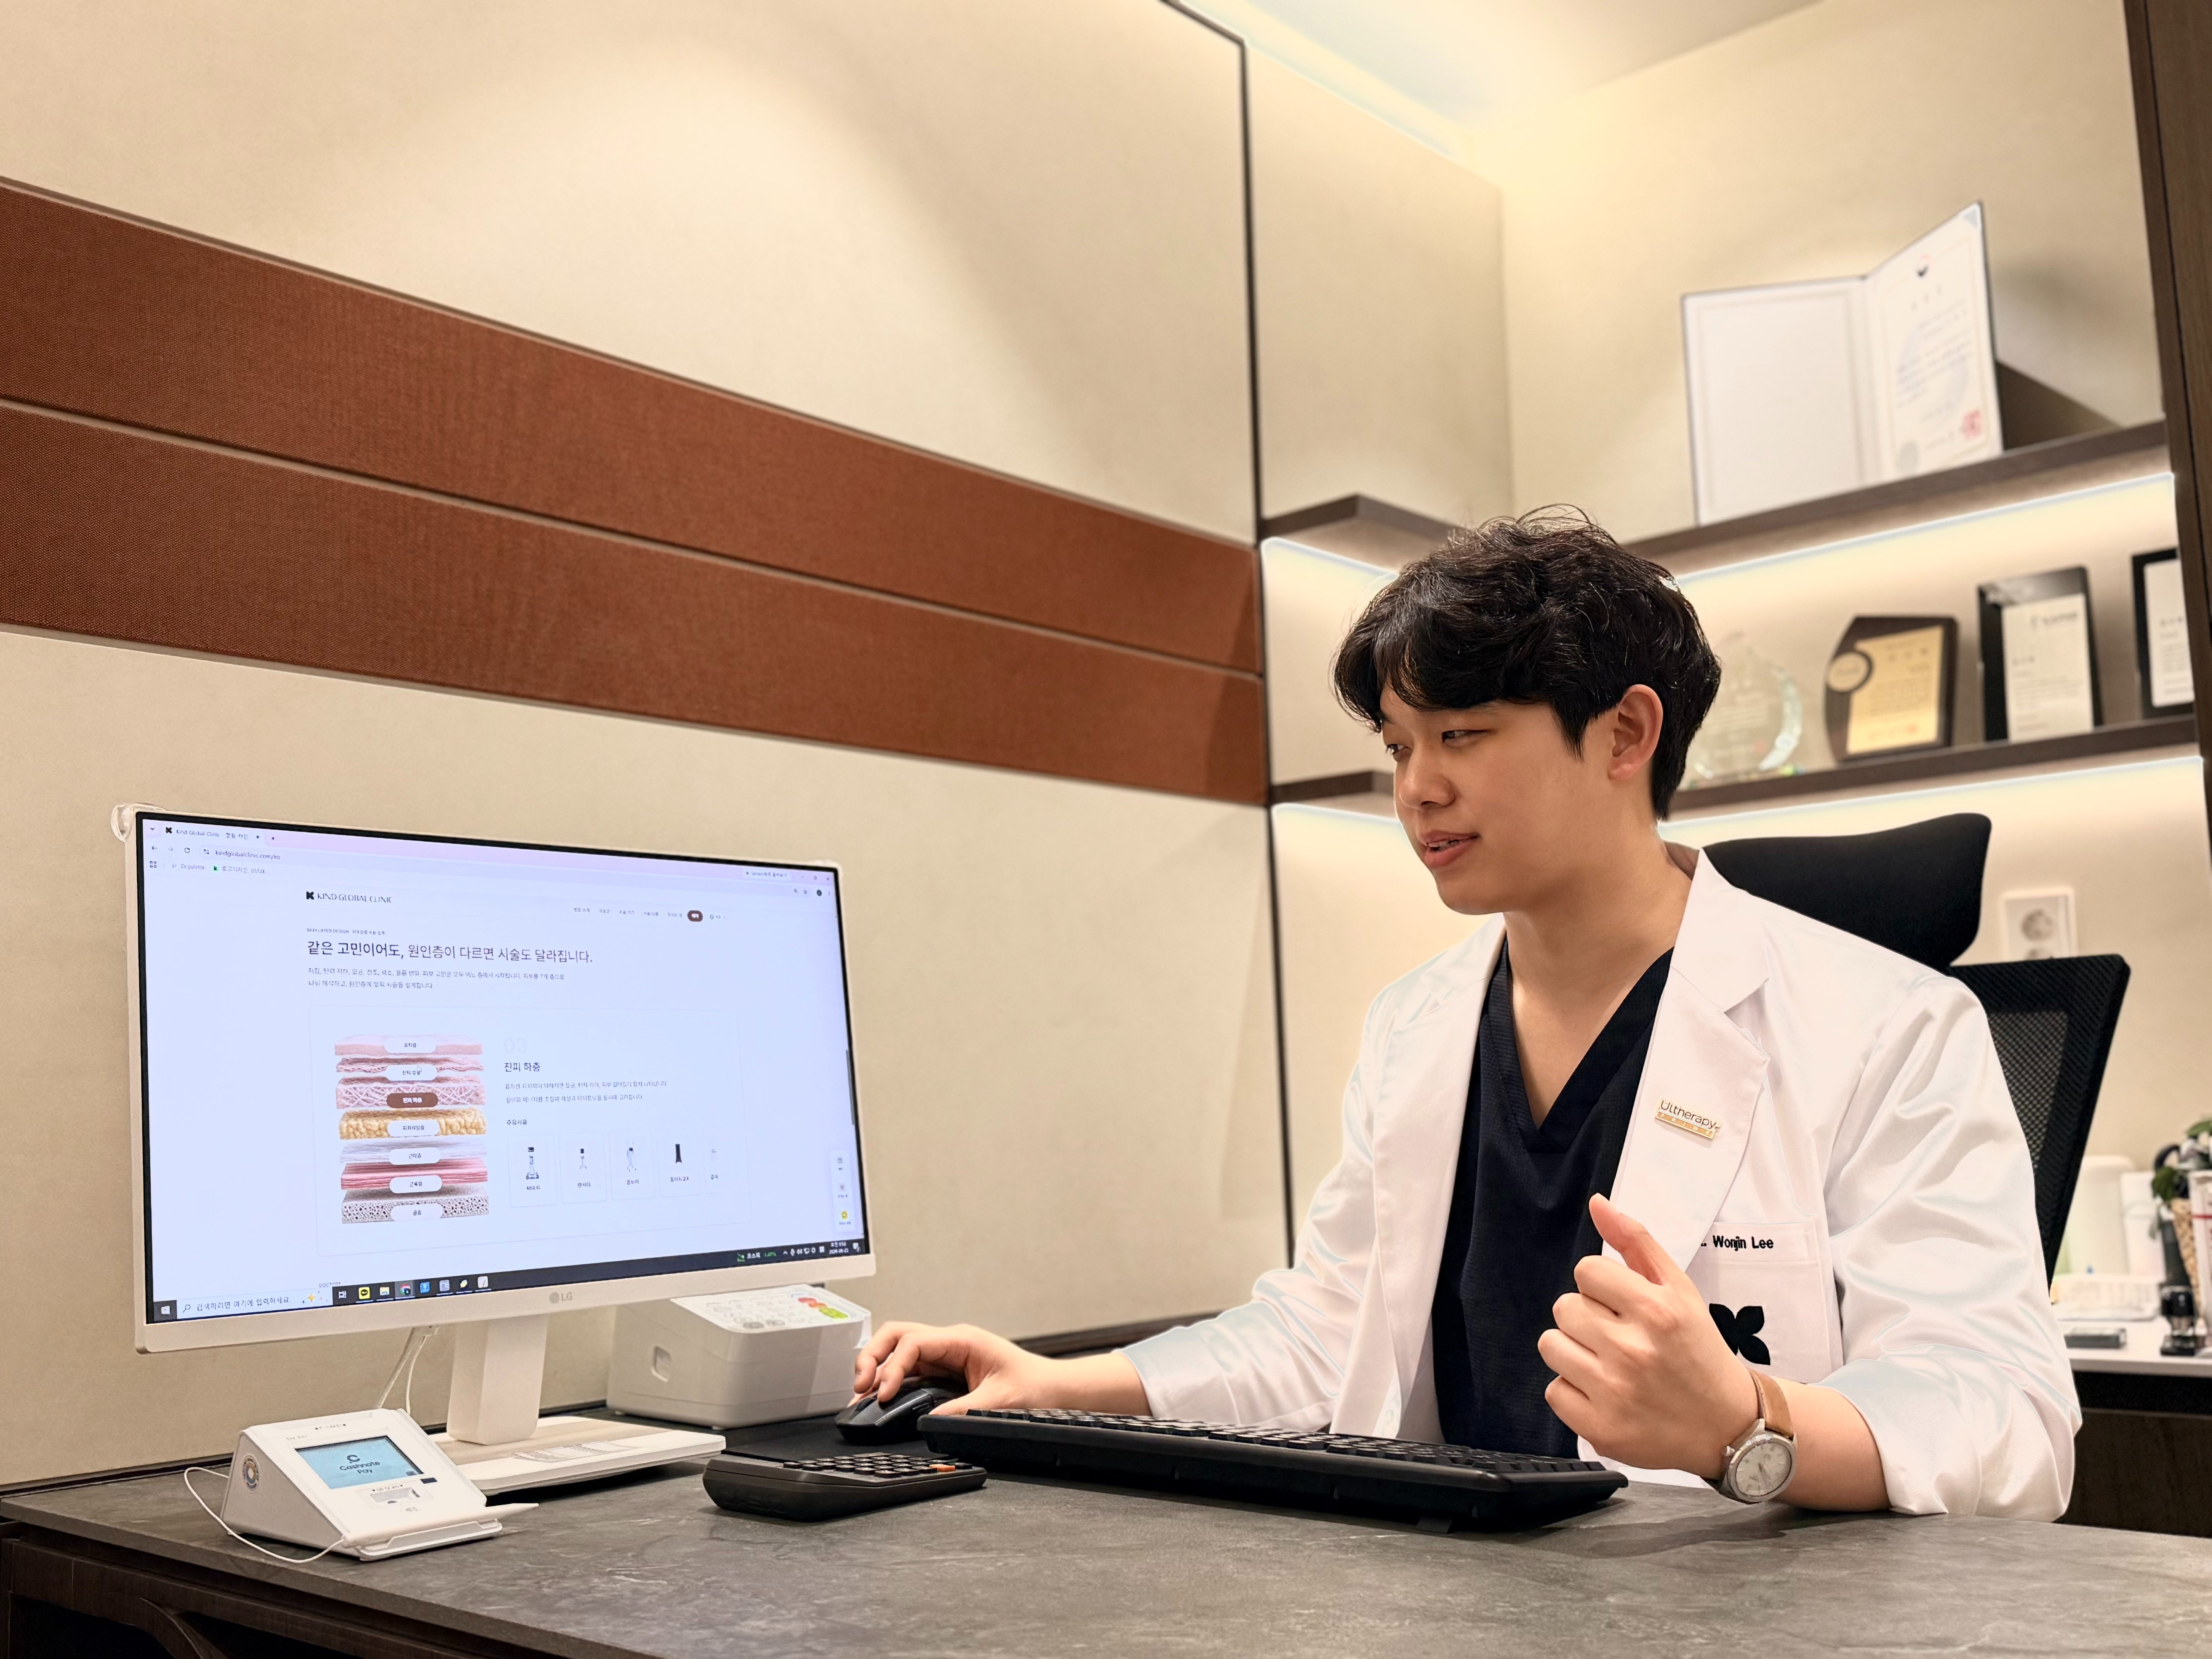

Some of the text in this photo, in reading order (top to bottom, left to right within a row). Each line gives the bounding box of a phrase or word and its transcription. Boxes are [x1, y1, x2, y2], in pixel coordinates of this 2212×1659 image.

[308, 941, 593, 963] 같은 고민이어도, 원인층이 다르면 시술도 달라집니다.
[504, 1062, 541, 1072] 진피 하층
[1661, 1100, 1717, 1129] Ultherapy
[1712, 1235, 1774, 1251] Wonjin Lee
[561, 1292, 572, 1301] LG
[197, 1301, 230, 1311] 검색하려면
[234, 1299, 253, 1307] 여기에
[339, 1461, 380, 1470] Cashnote
